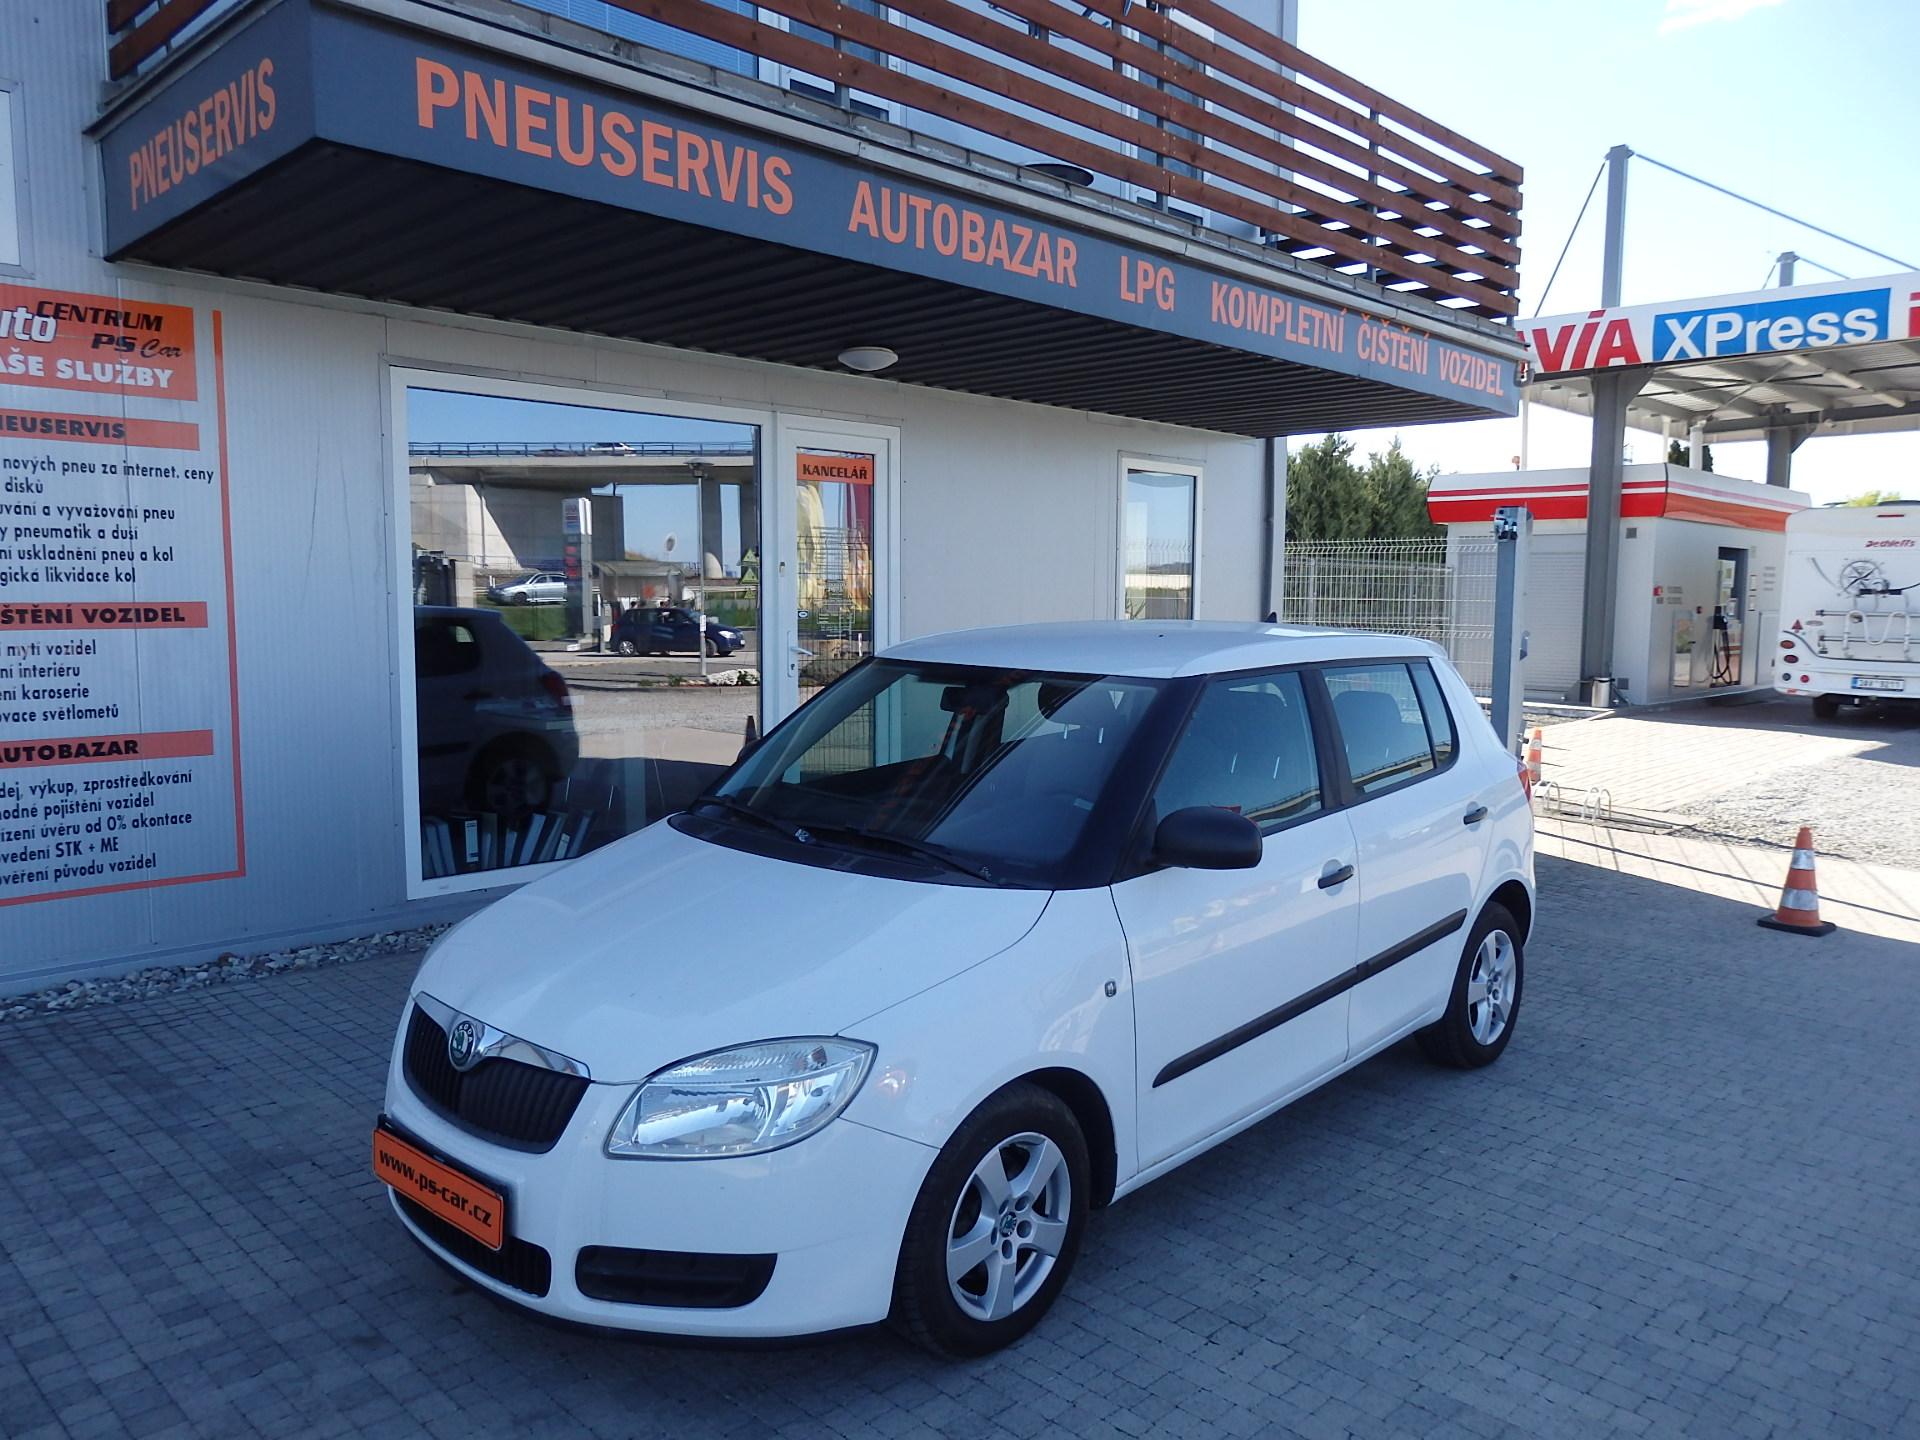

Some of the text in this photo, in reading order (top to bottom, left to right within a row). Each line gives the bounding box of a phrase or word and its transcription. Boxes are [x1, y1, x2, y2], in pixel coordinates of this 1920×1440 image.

[128, 57, 276, 211] PNEUSERVIS
[415, 56, 1504, 397] PNEUSERVIS AUTOBAZAR LPG KOMPLETNÍ ČIŠTĚNÍ VOZIDEL
[36, 300, 164, 332] CENTRUM
[1659, 306, 1880, 362] XPress
[56, 359, 174, 388] SLUŽBY
[0, 414, 127, 439] EUSERVIS
[3, 456, 214, 484] nových pneu za internet. ceny
[802, 463, 868, 480] KANCELÁŘ
[4, 477, 44, 494] disků
[42, 505, 51, 516] a
[57, 503, 139, 521] vyvažování
[143, 506, 176, 523] pneu
[14, 525, 92, 542] pneumatik
[98, 529, 106, 539] a
[18, 544, 97, 561] uskladnění
[101, 549, 135, 564] pneu
[140, 551, 148, 562] a
[153, 546, 174, 562] kol
[45, 566, 110, 583] likvidace
[115, 567, 136, 583] kol
[0, 604, 186, 625] ŠTĚNÍ VOZIDEL
[46, 639, 97, 655] vozidel
[19, 662, 80, 678] interiéru
[22, 682, 90, 700] karoserie
[0, 703, 119, 723] vace světlometů
[0, 739, 139, 763] UTOBAZAR
[83, 769, 192, 794] zprostředkování
[0, 792, 155, 820] odné pojištění vozidel
[41, 823, 81, 838] úvěru
[85, 817, 102, 833] od
[106, 815, 127, 831] 0%
[132, 813, 193, 829] akontace
[55, 840, 83, 858] STK
[100, 836, 119, 853] ME
[0, 853, 157, 885] věření původu vozidel
[379, 1150, 492, 1228] www.ps-car.cz
